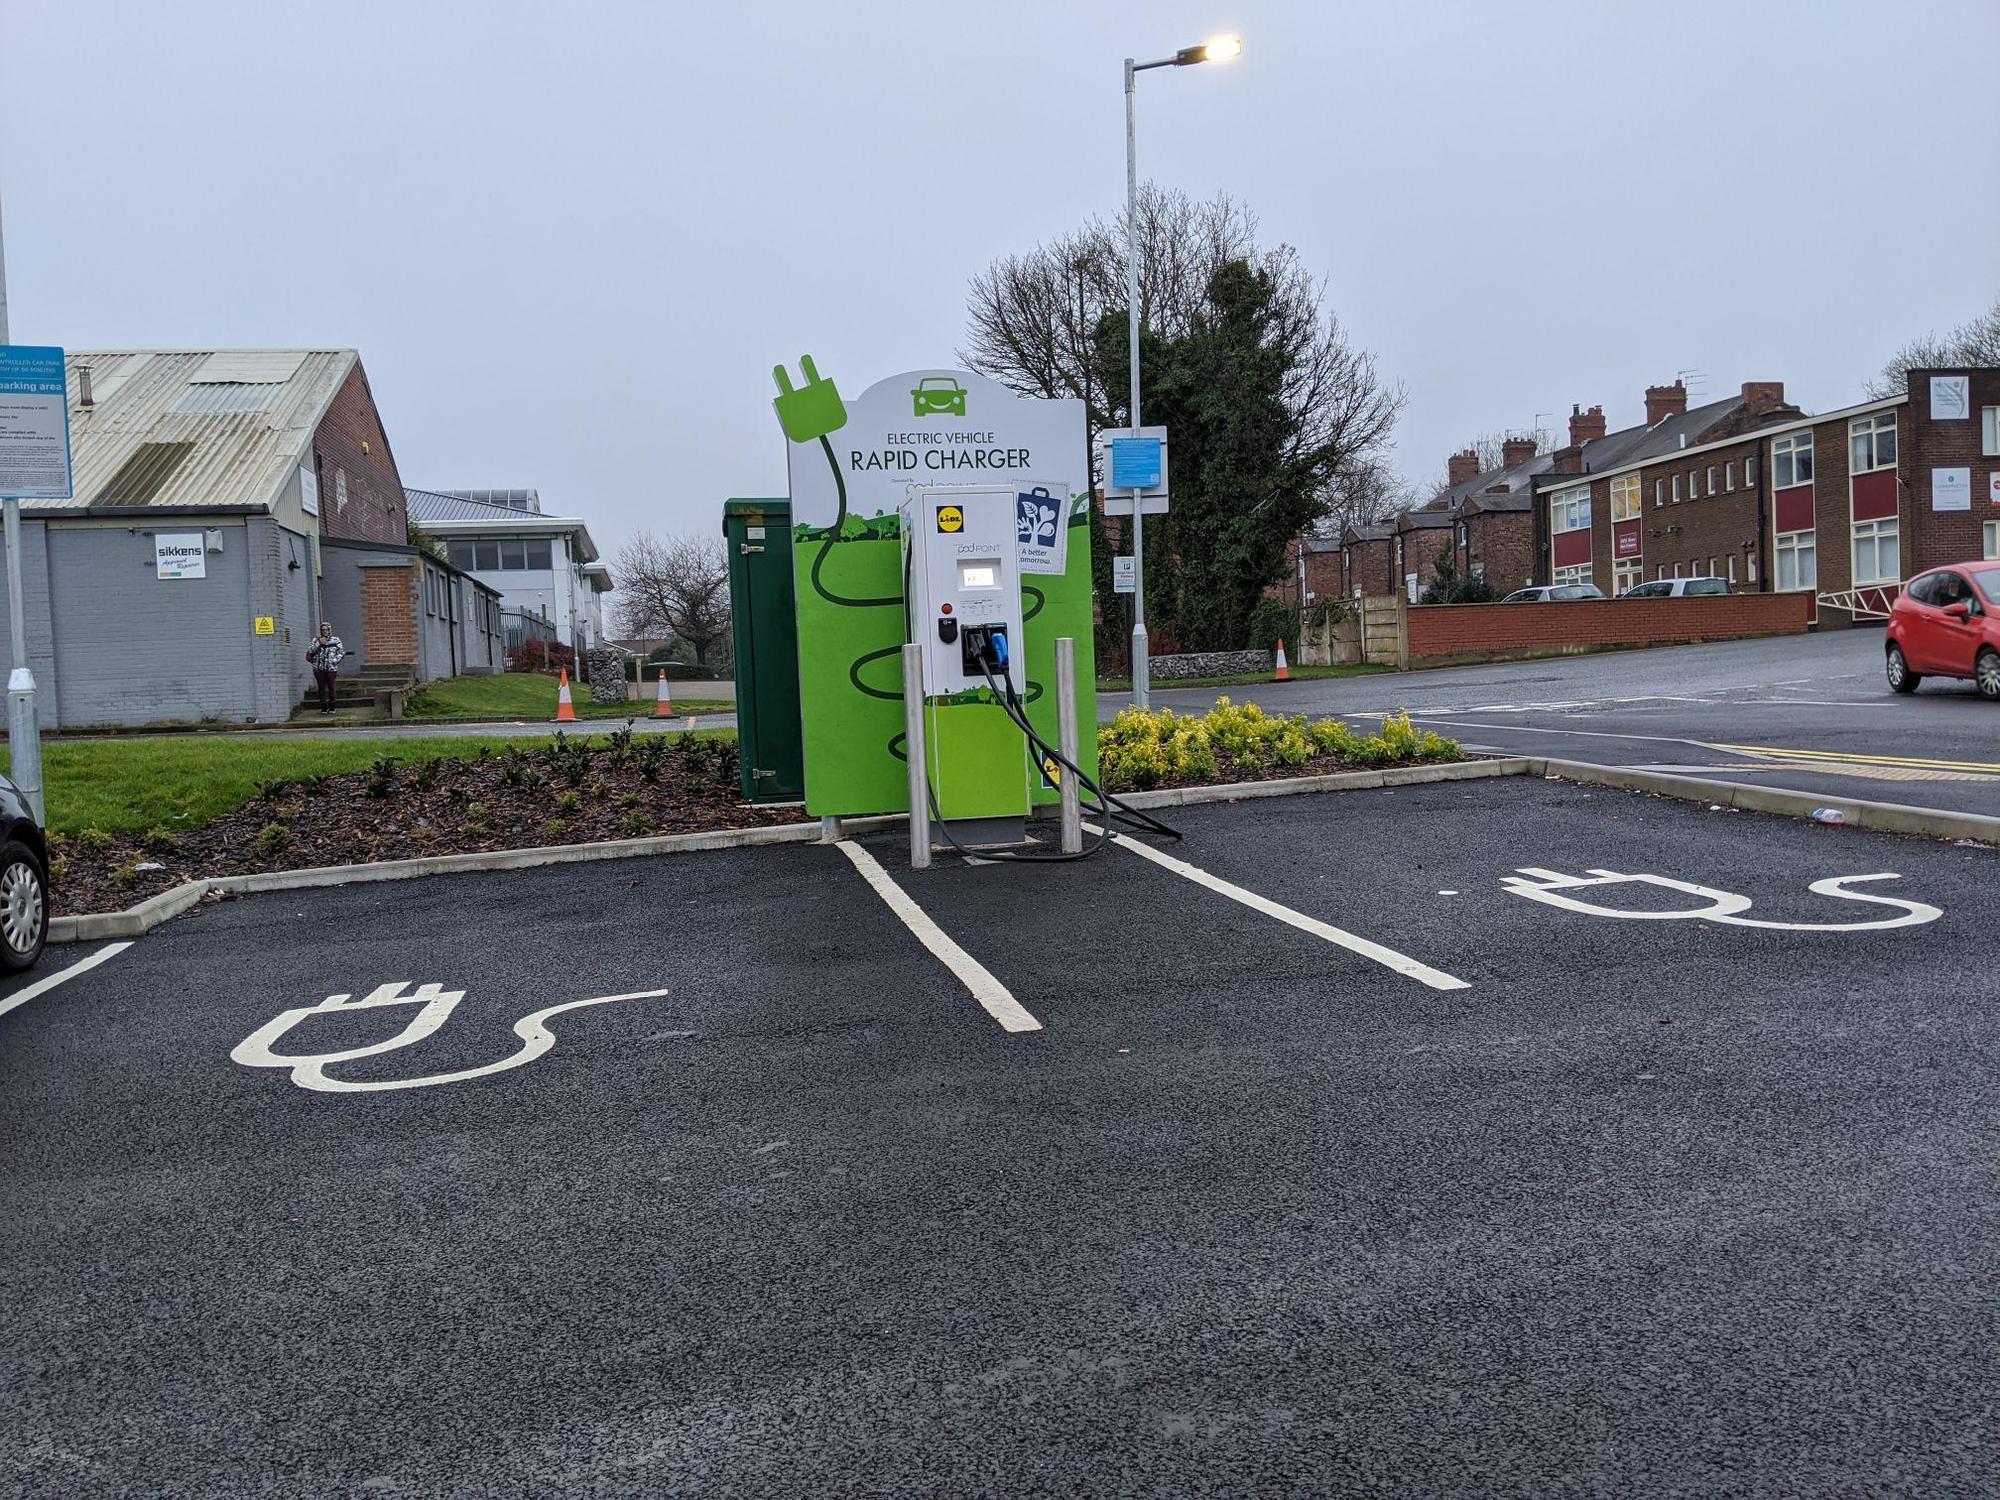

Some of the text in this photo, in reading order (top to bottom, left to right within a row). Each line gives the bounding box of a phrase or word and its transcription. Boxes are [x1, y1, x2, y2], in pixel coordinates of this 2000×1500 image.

[887, 432, 994, 445] ELECTRIC VEHICLE
[851, 449, 1031, 471] RAPID CHARGER
[158, 546, 202, 556] sikkens
